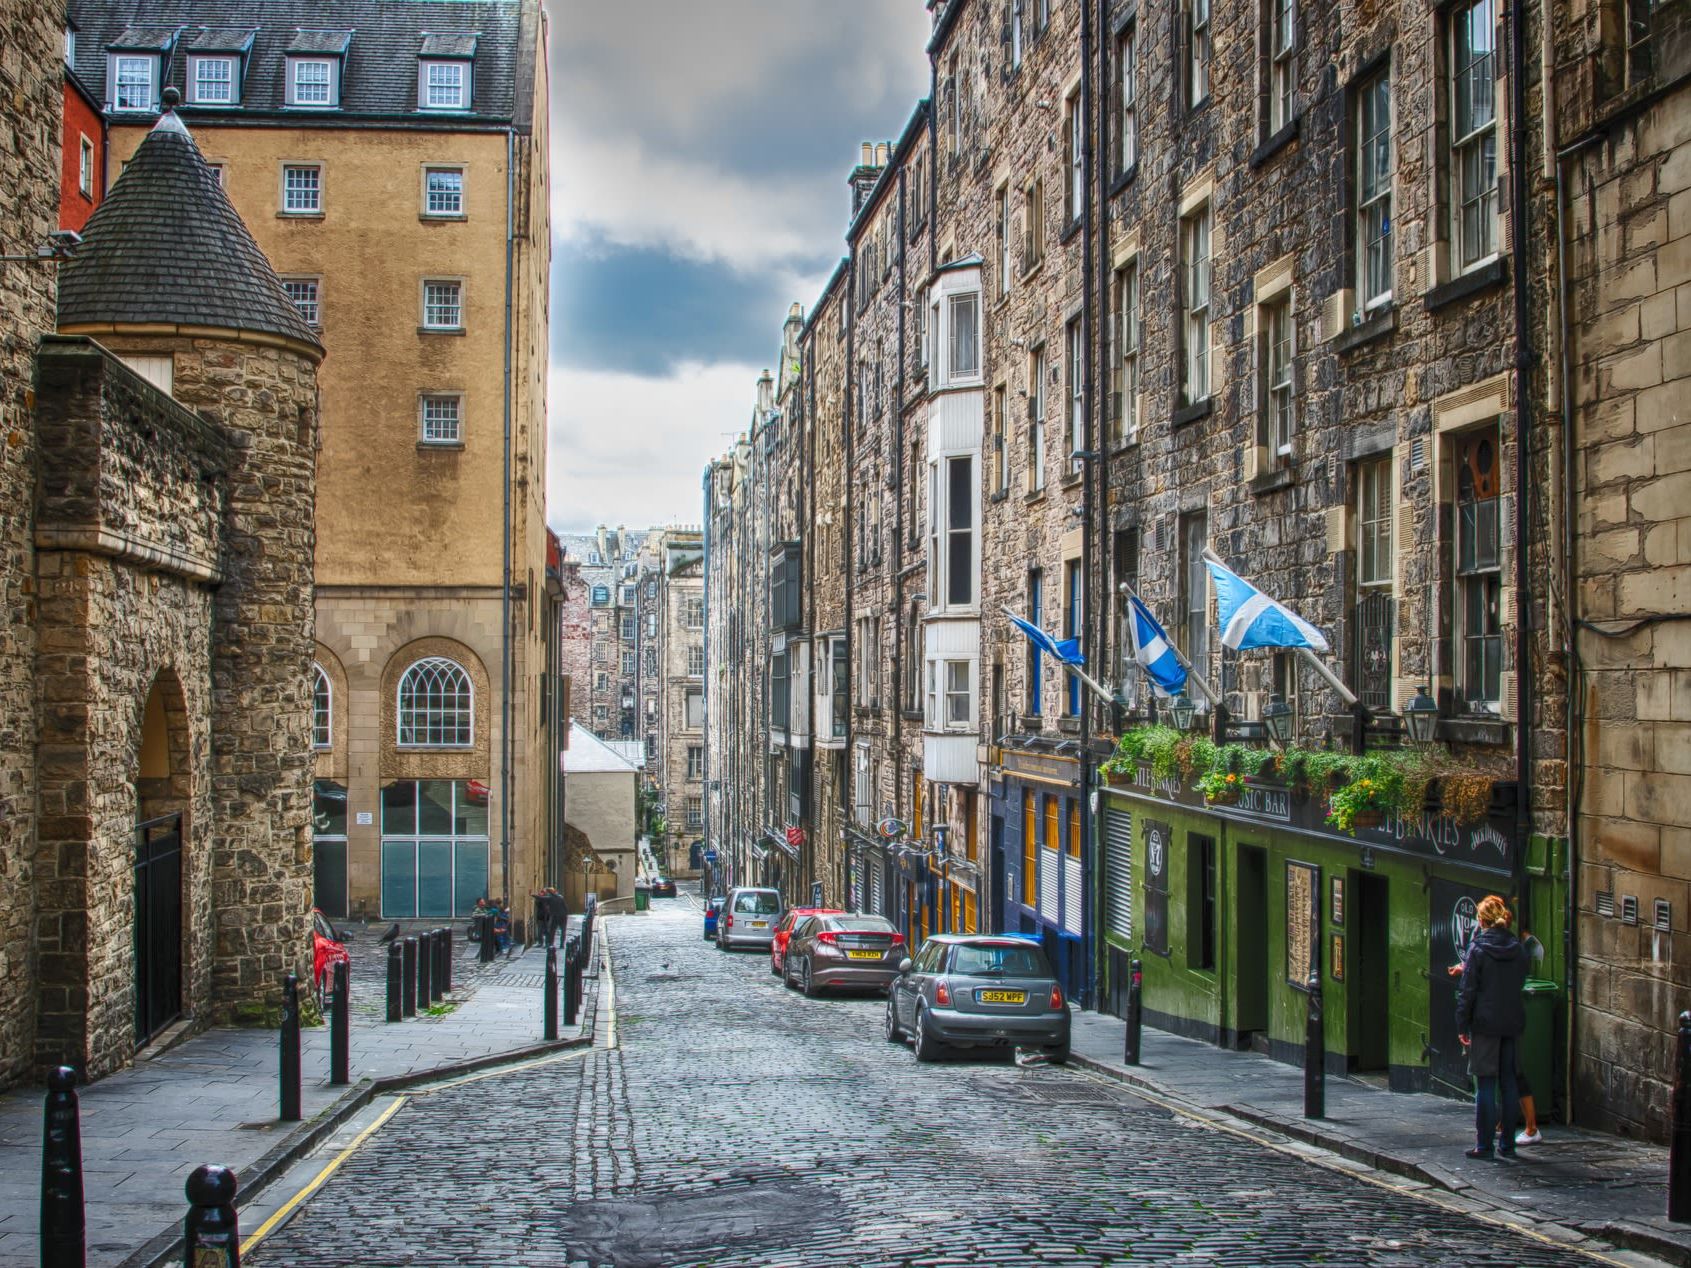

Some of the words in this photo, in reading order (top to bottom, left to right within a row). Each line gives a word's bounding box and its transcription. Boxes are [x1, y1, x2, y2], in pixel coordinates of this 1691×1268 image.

[1235, 788, 1261, 810] USIC
[1265, 791, 1287, 815] BAR
[1461, 902, 1474, 914] OLD
[982, 991, 1005, 1001] SJ52
[1006, 991, 1024, 1001] WPF
